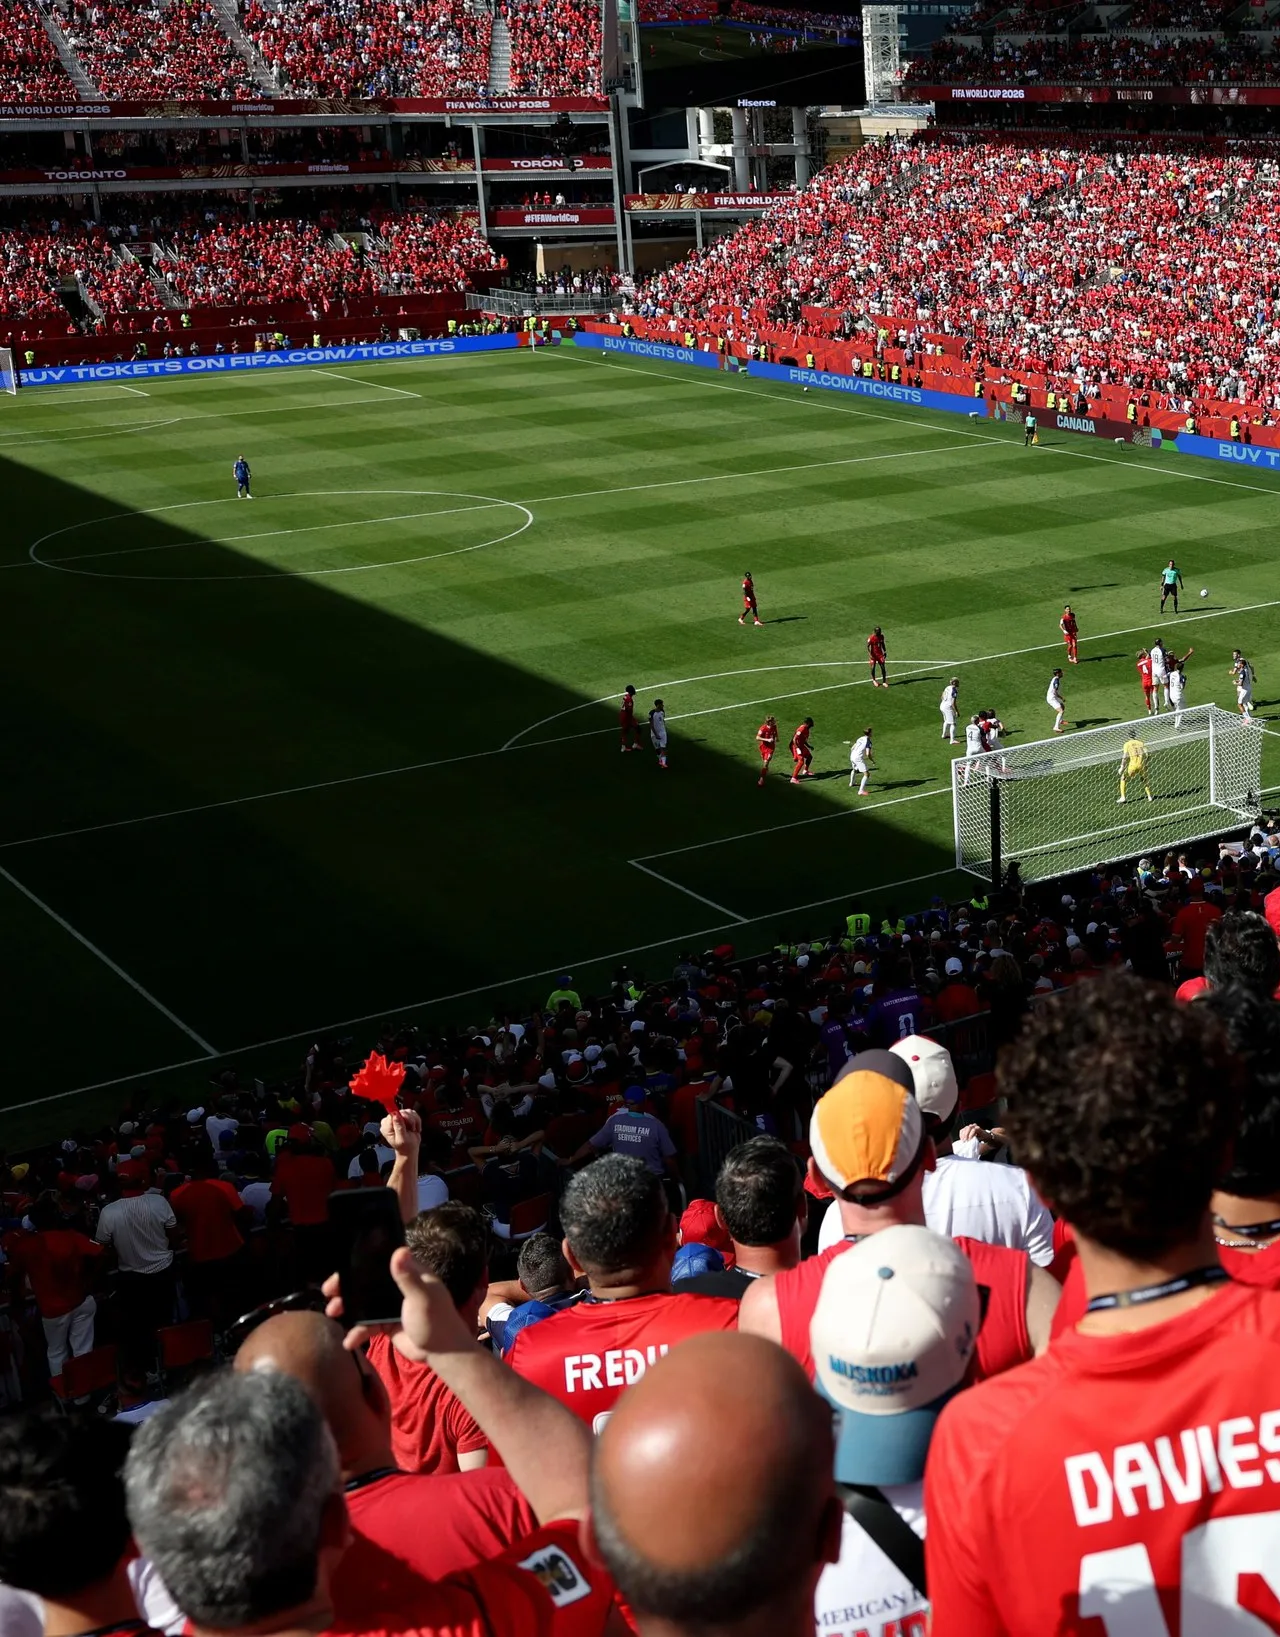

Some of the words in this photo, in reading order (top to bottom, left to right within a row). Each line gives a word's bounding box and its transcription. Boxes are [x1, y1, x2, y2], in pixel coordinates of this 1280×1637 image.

[952, 89, 965, 98] FIFA
[965, 89, 988, 98] WORLD
[989, 89, 1001, 98] CUP
[1002, 89, 1025, 99] 2026
[1117, 90, 1153, 100] TORONTO
[231, 103, 275, 113] #FIFAWorldCup
[446, 101, 465, 110] FIFA
[499, 100, 518, 110] CUP
[518, 100, 550, 109] 2026
[737, 99, 777, 107] Hisense
[15, 106, 52, 115] WORLD
[54, 106, 74, 114] CUP
[76, 105, 111, 114] 2026
[511, 160, 583, 169] TORONO
[45, 169, 127, 180] TORONTO
[714, 196, 736, 205] FIFA
[736, 196, 772, 205] WORLD
[524, 213, 579, 224] #FIFAWorldCup
[604, 337, 626, 349] BUY
[628, 341, 680, 359] TICKETS
[681, 350, 694, 362] ON
[16, 369, 66, 384] BUY
[72, 361, 182, 378] TICKETS
[187, 357, 224, 370] ON
[231, 341, 455, 367] FIFA.COM/TICKETS
[790, 369, 922, 403] FIFA.COM/TICKETS
[1057, 414, 1096, 433] CANADA
[1219, 443, 1261, 463] BUY
[614, 1124, 636, 1135] STADIUM
[637, 1124, 651, 1136] FAN
[617, 1133, 642, 1144] SERVICES
